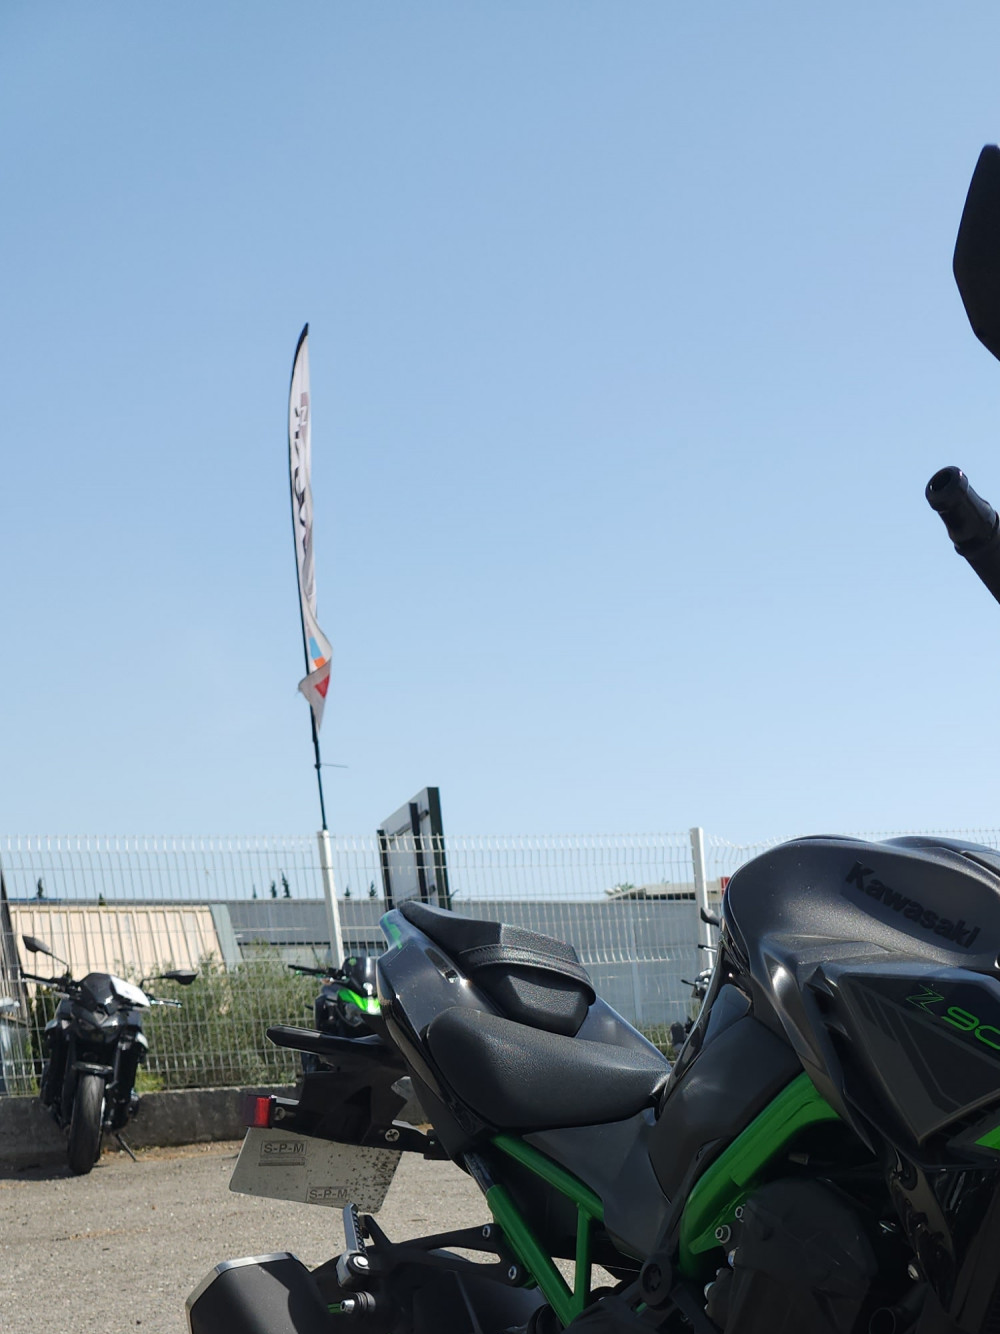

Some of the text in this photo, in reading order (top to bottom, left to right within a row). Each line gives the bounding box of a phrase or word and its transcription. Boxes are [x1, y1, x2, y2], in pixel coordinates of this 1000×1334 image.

[845, 859, 982, 950] Kawasaki
[263, 1143, 306, 1154] S-P-M
[309, 1188, 349, 1200] S-P-M
